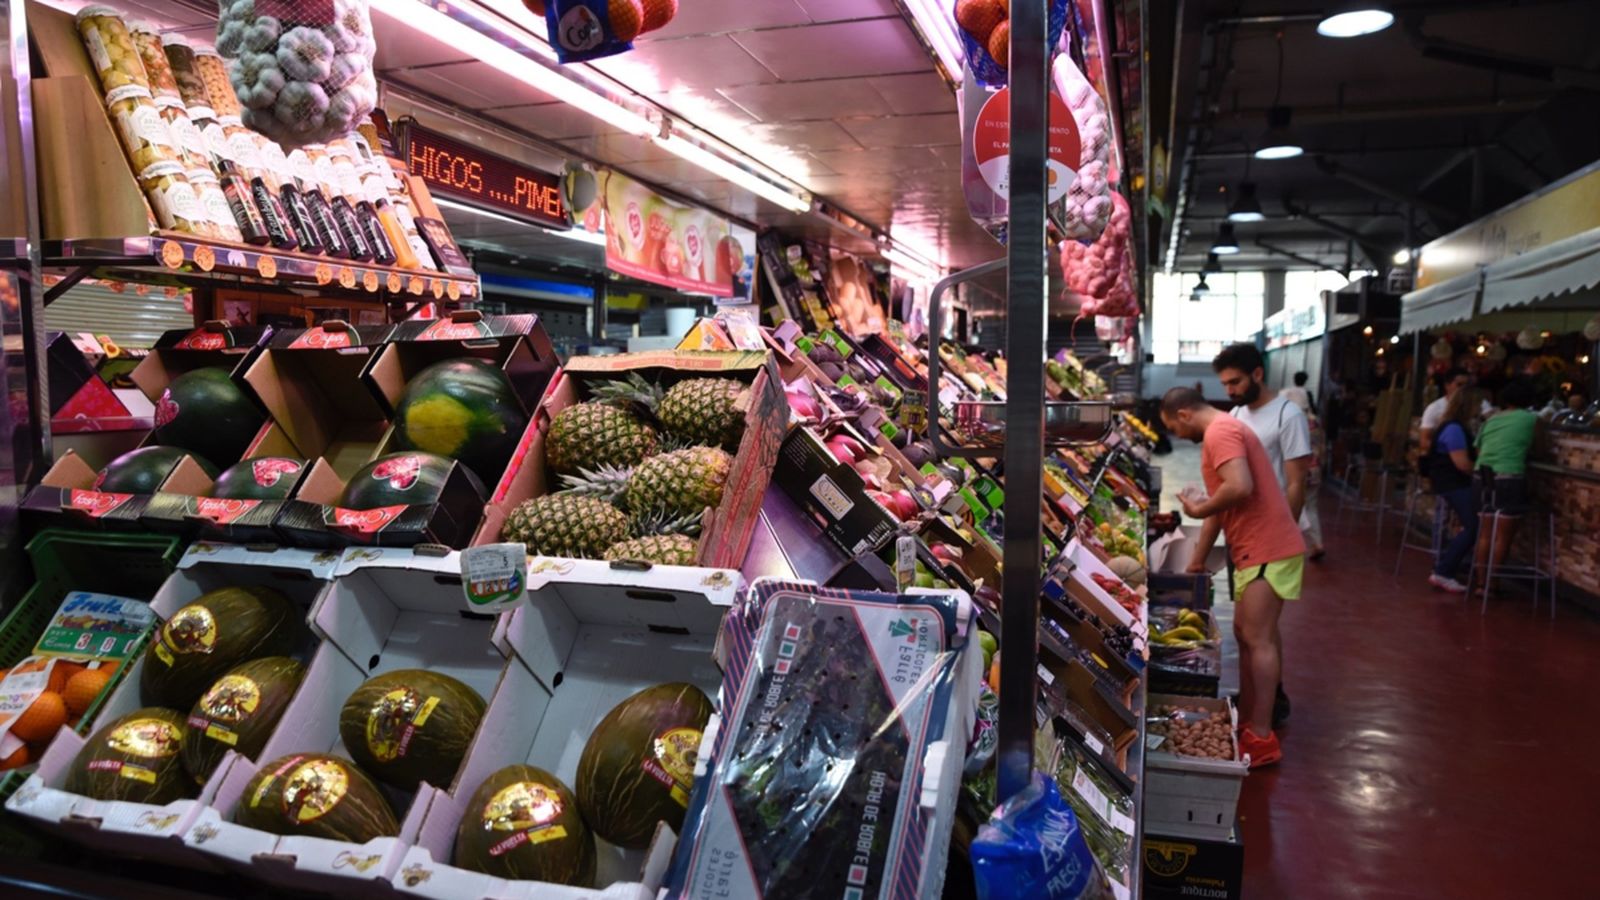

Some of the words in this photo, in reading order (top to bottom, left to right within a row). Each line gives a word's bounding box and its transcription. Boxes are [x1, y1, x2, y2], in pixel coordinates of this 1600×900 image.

[995, 120, 1009, 128] EST
[1049, 127, 1070, 135] IENTO
[411, 142, 483, 193] HIGOS
[63, 593, 123, 614] Fruta
[1181, 886, 1228, 899] BOUTIQUE
